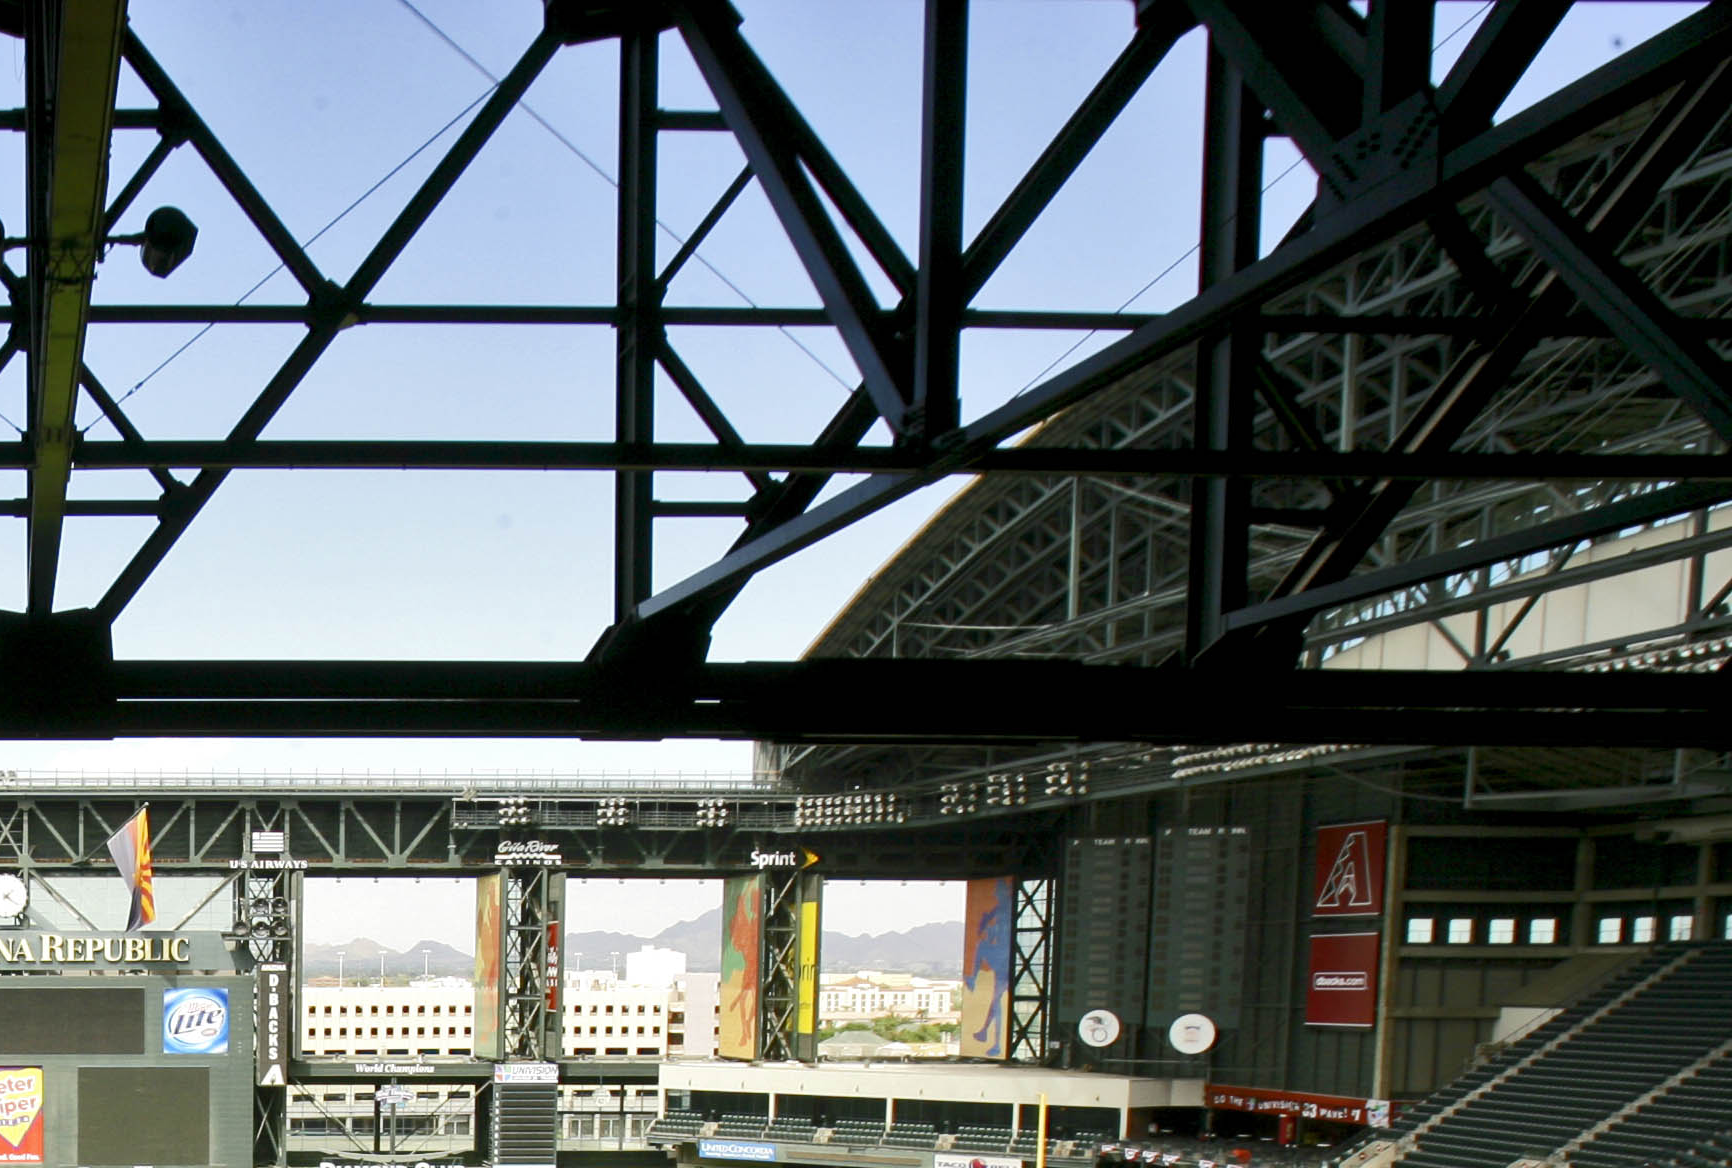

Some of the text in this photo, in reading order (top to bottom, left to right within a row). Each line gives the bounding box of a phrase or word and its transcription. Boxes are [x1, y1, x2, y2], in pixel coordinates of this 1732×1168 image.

[497, 840, 559, 853] Gila River
[250, 860, 308, 869] AIRWAYS
[750, 850, 796, 870] Sprint
[40, 934, 190, 964] REPUBLIC
[173, 1008, 223, 1036] Lite
[354, 1063, 435, 1075] World Champions
[511, 1065, 558, 1075] UNIVISION
